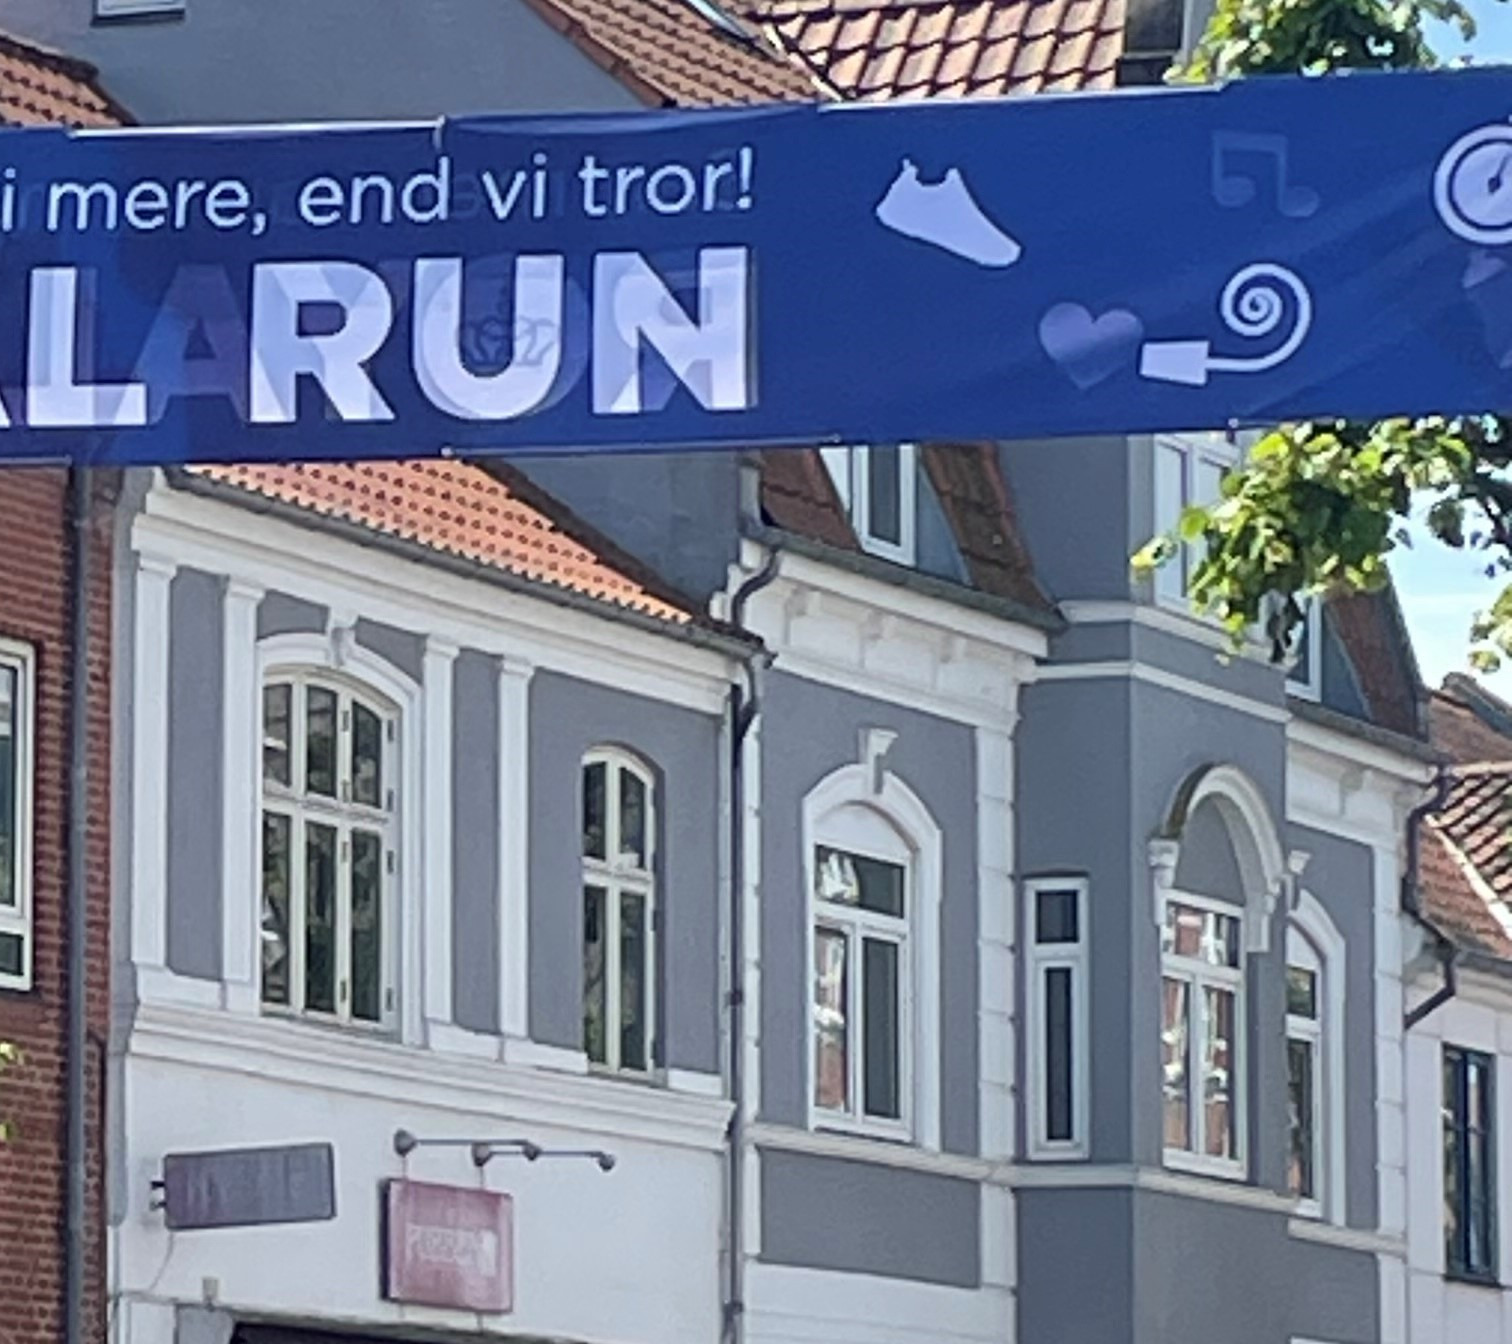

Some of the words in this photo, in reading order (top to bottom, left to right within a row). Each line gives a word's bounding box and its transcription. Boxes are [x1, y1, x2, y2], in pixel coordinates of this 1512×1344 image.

[47, 180, 266, 237] mere,
[299, 156, 449, 225] end
[482, 158, 546, 220] vi
[578, 147, 751, 215] tror!
[249, 246, 748, 424] RUN
